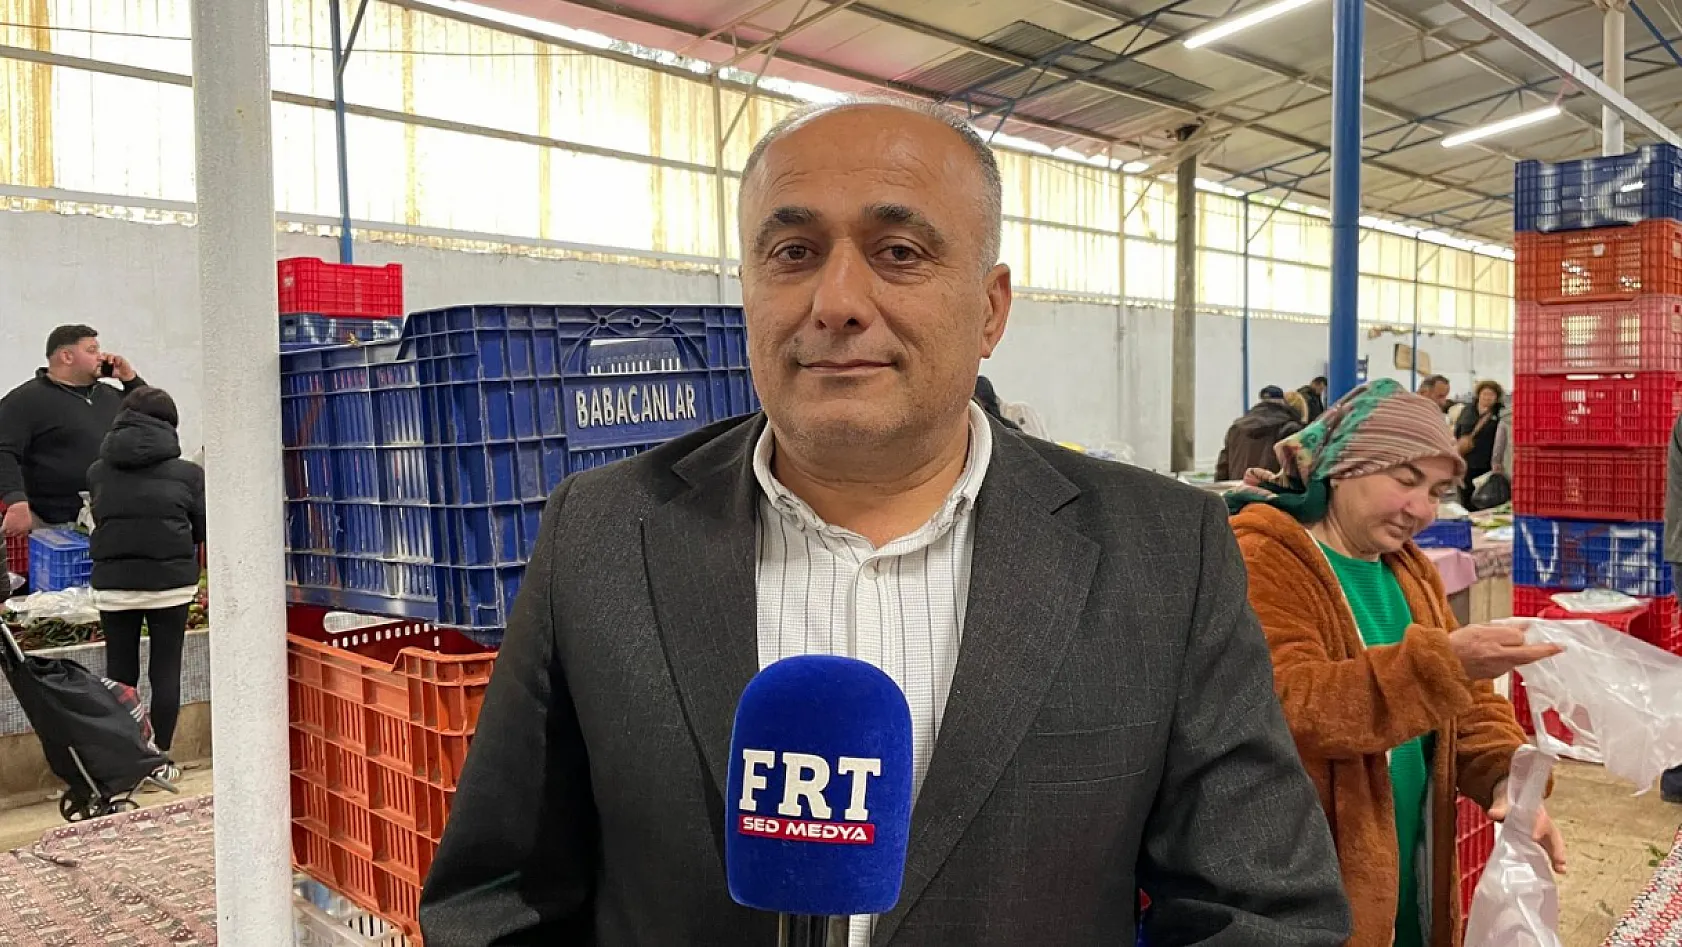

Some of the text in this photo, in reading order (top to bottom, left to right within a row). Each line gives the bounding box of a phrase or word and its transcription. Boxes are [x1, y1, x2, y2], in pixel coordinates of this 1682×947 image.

[575, 383, 697, 429] BABACANLAR
[738, 748, 881, 821] FRT
[742, 816, 868, 840] SED MEDYA
